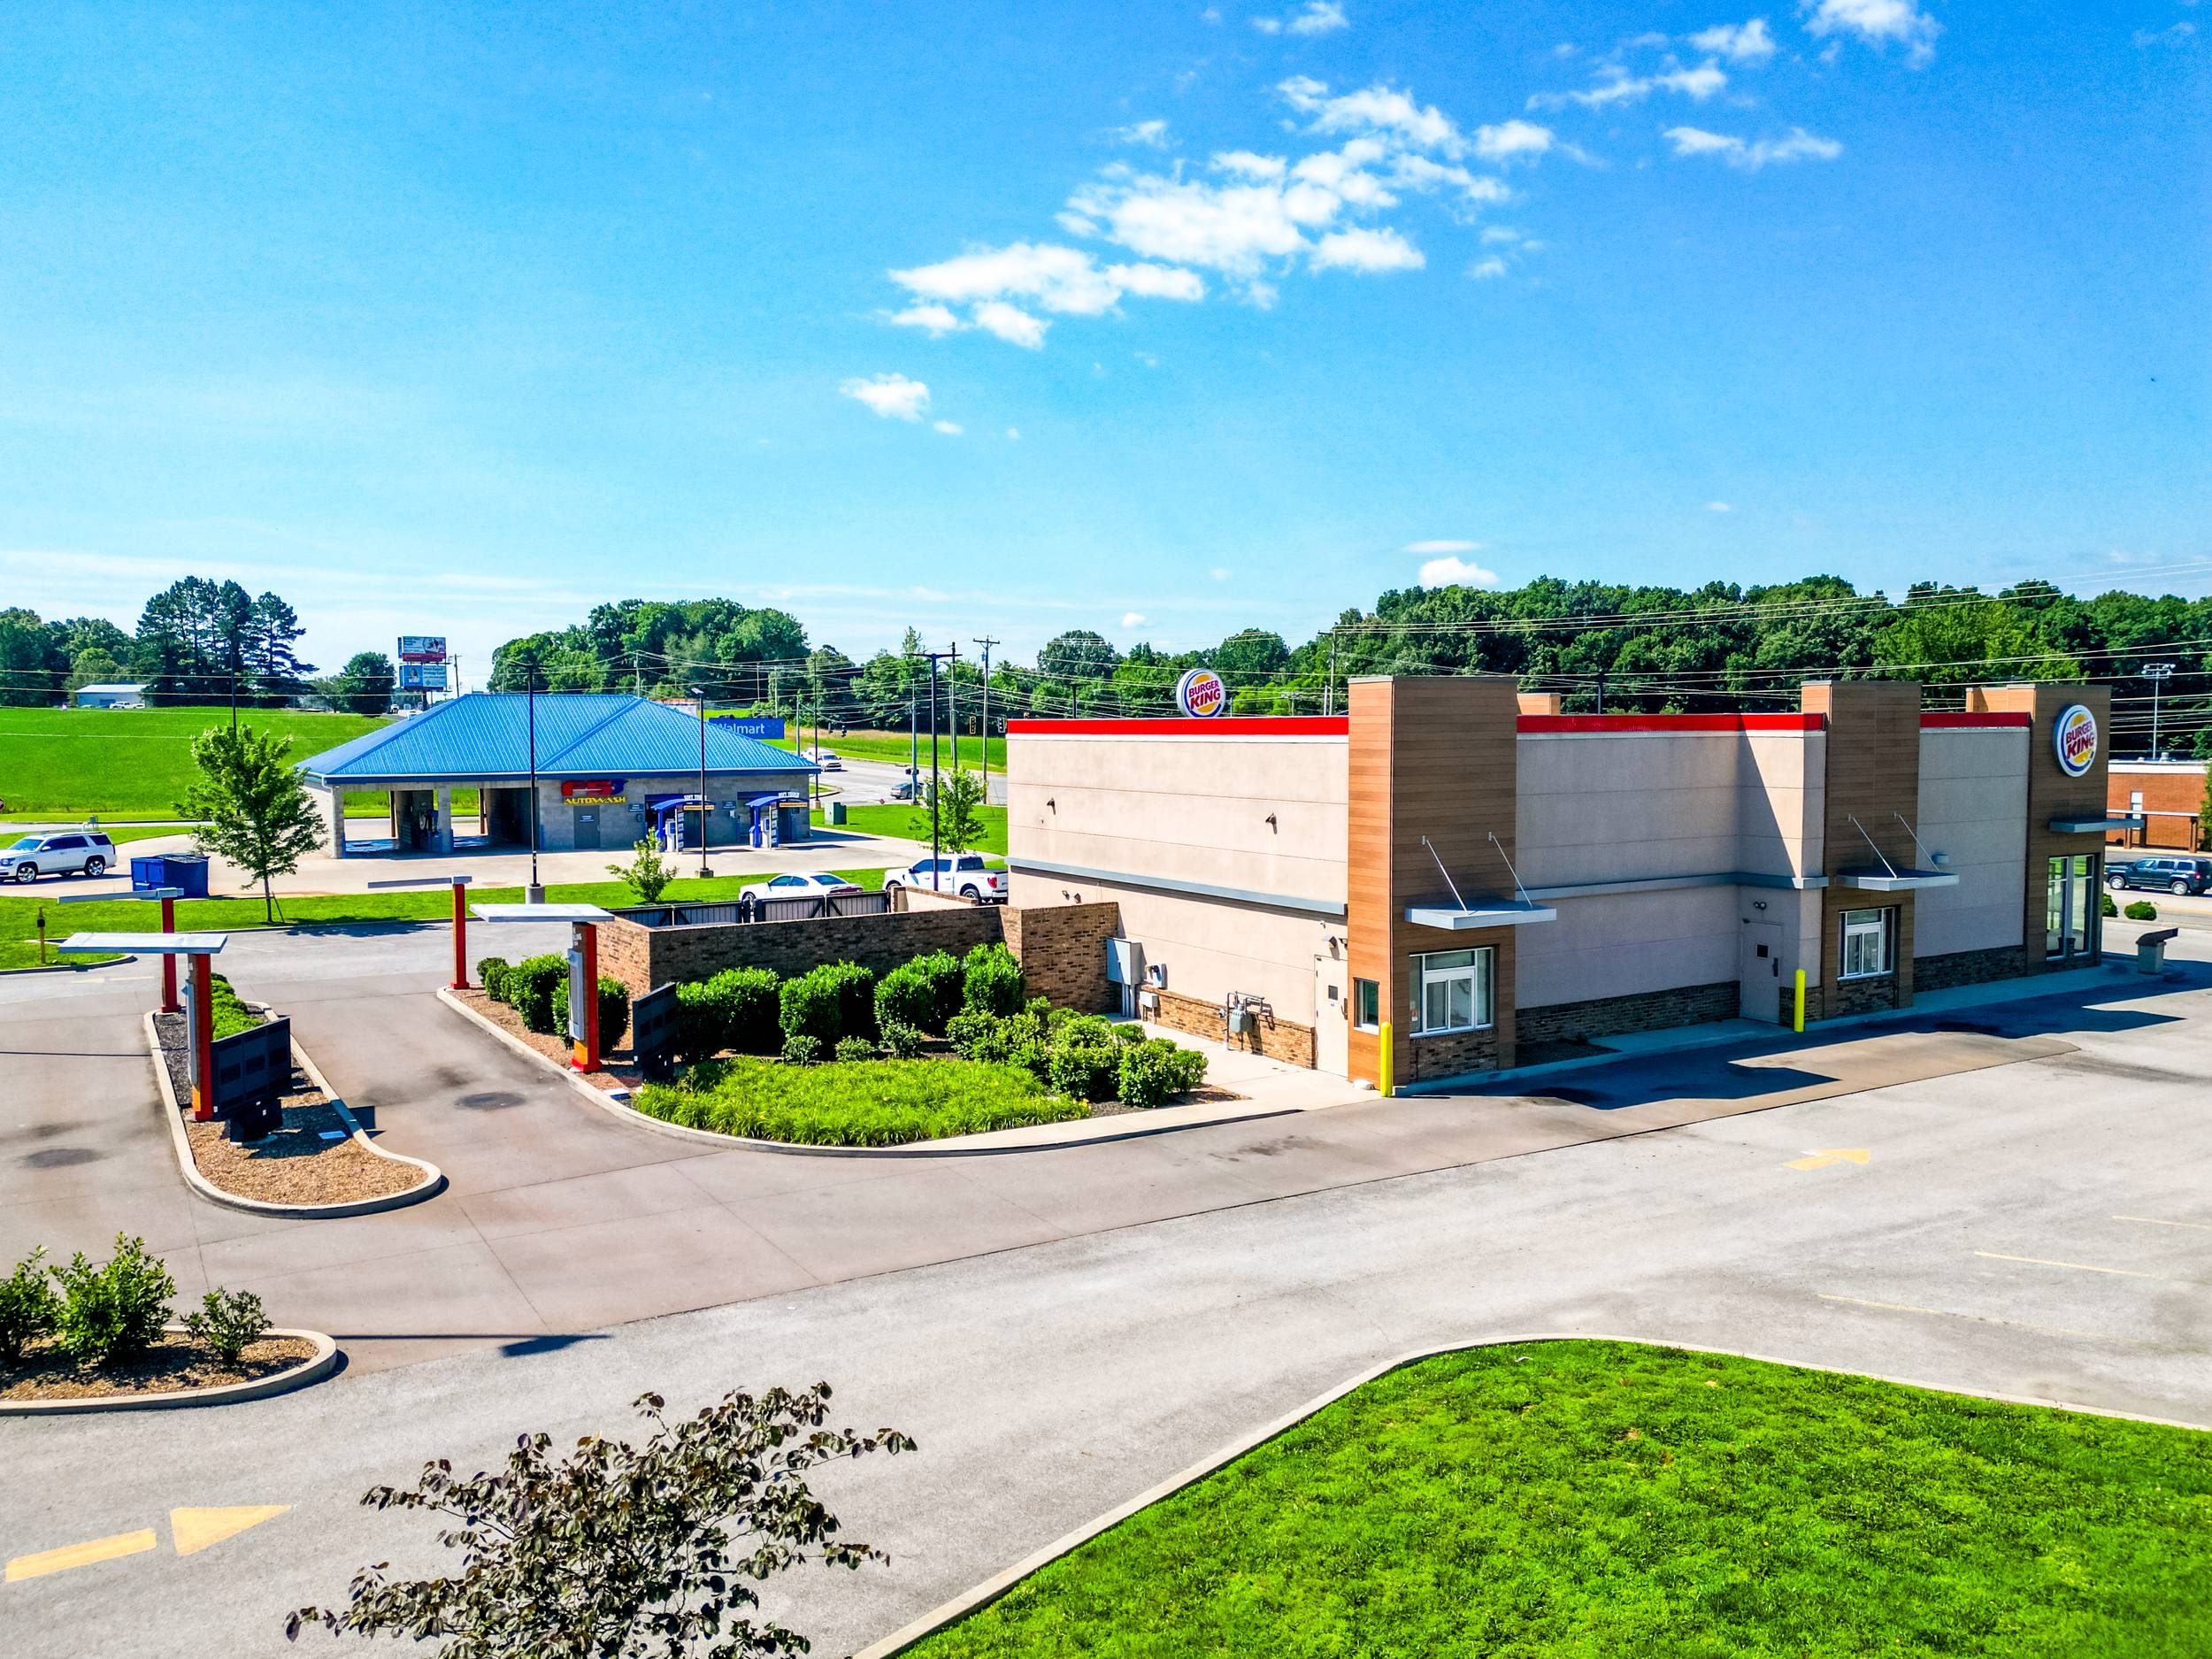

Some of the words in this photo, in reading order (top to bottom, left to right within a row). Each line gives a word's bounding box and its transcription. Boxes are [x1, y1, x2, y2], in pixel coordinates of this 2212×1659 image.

[1188, 680, 1219, 698] BURGER
[1190, 688, 1221, 710] KING
[2066, 721, 2093, 745] BURGER
[2067, 732, 2095, 760] KING
[564, 796, 626, 806] AUTOWASH
